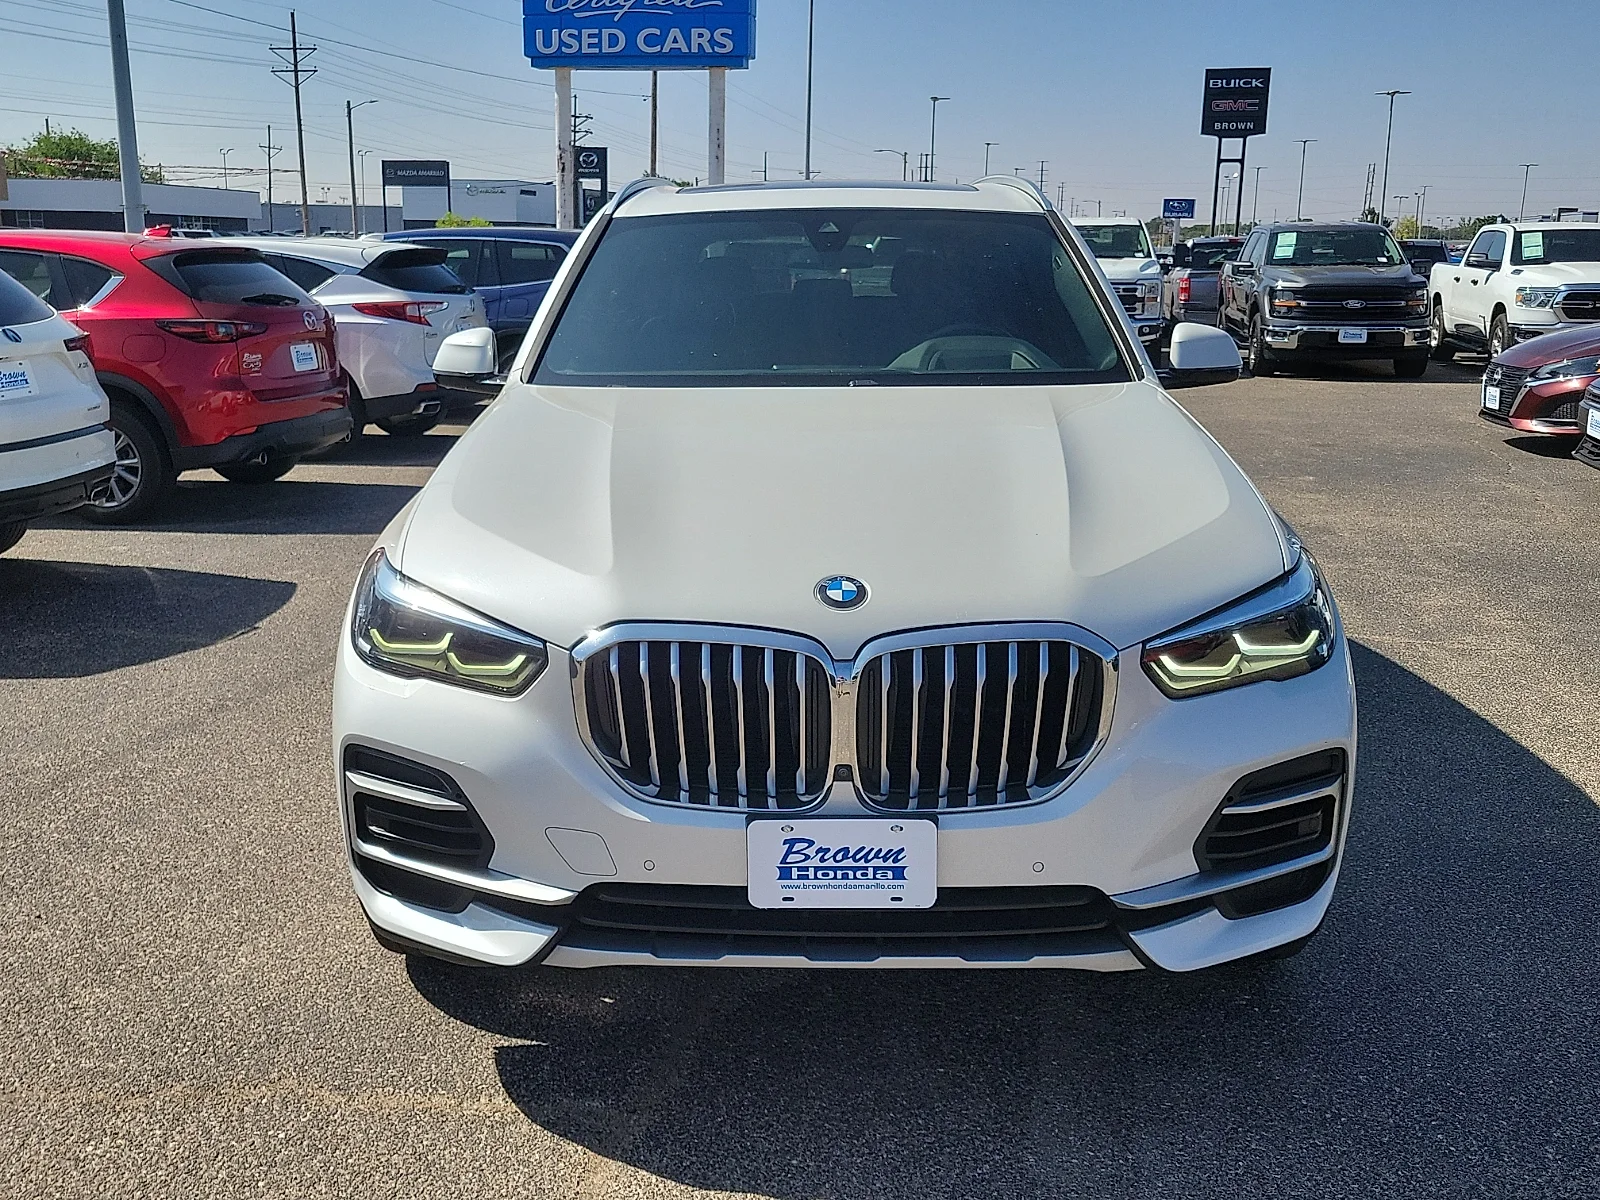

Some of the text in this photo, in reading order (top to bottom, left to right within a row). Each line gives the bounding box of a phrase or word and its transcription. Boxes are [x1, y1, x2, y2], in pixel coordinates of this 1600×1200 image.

[535, 28, 734, 54] USED CARS
[1209, 78, 1265, 88] BUICK
[1211, 99, 1260, 111] GMC
[1214, 122, 1254, 130] BROWN
[820, 576, 862, 587] BMW
[779, 837, 907, 865] Brown
[791, 867, 893, 880] Honda
[780, 882, 905, 890] www.brownhondaamarillo.com
